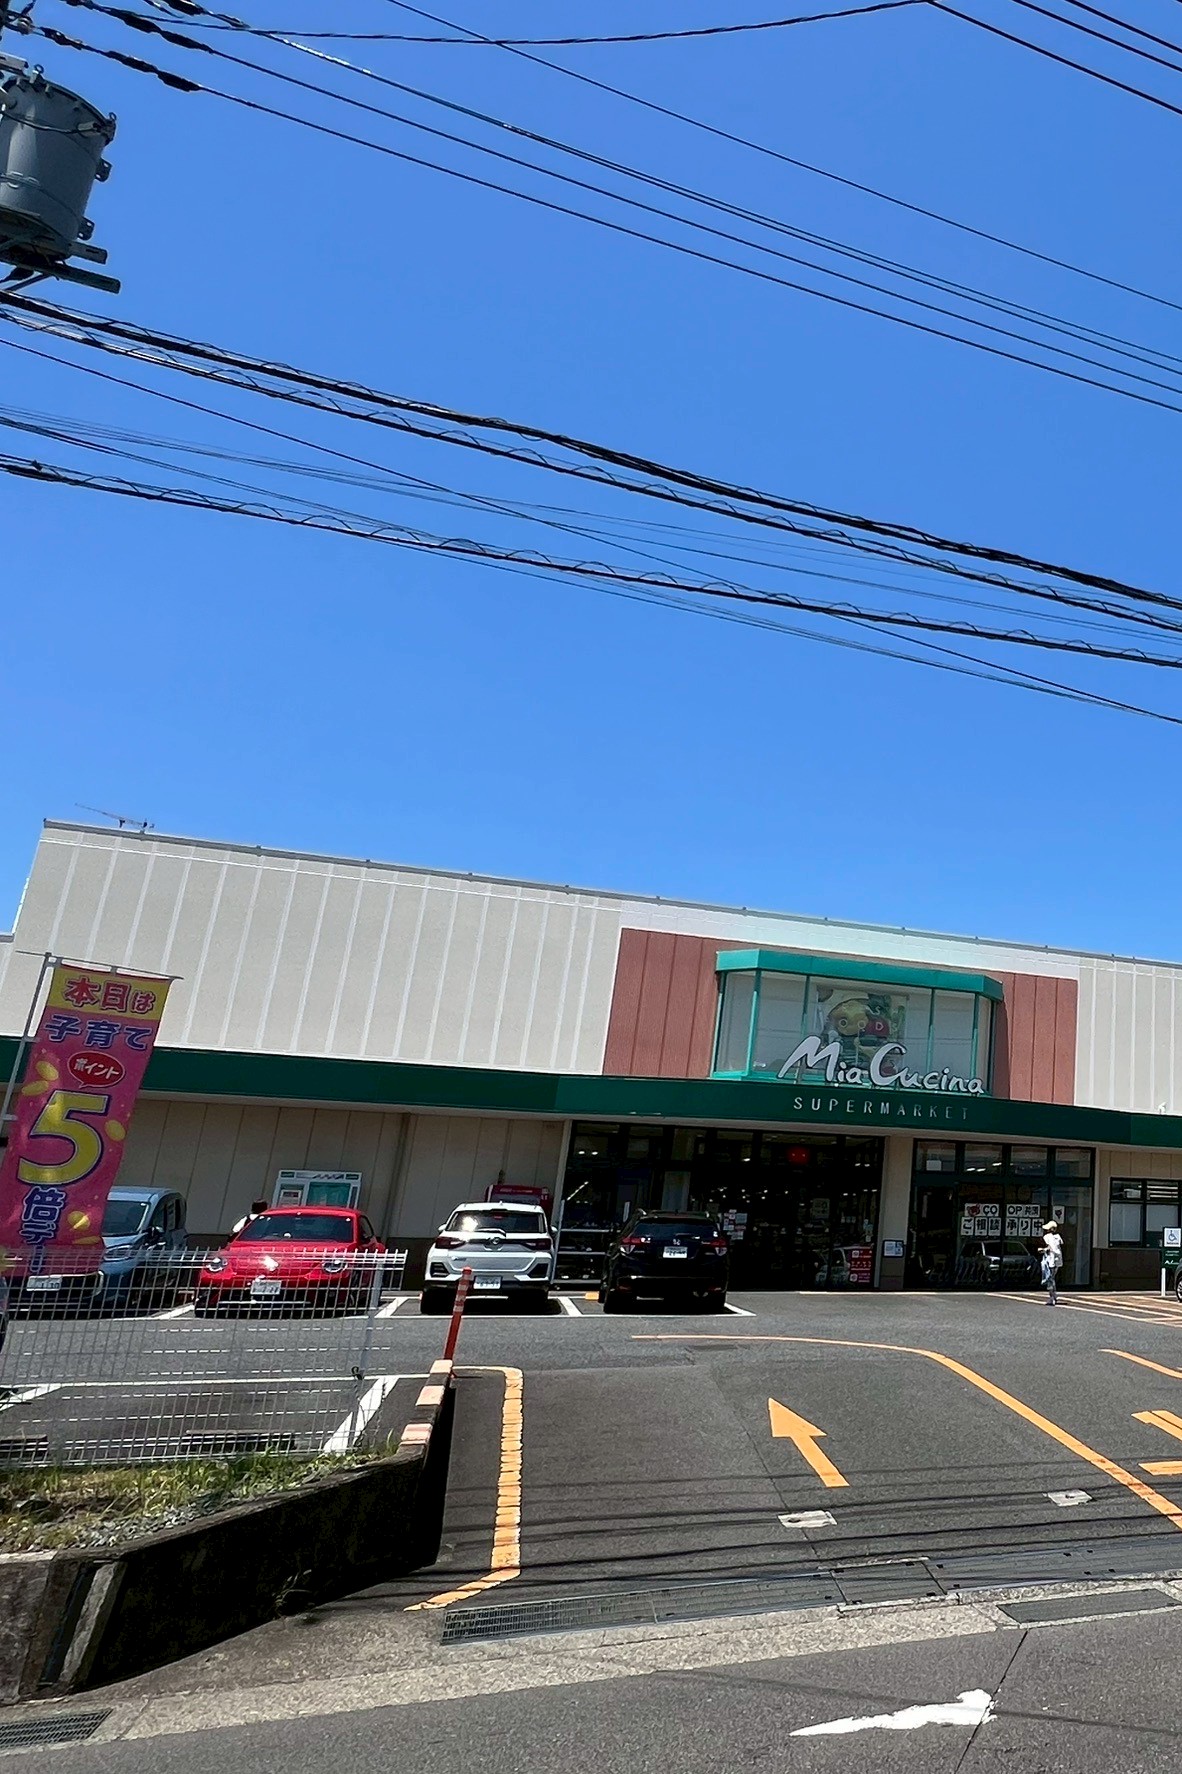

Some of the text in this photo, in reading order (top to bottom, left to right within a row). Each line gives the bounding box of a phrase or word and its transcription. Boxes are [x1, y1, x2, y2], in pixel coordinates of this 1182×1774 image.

[63, 976, 156, 1014] 本日は
[45, 1014, 152, 1050] 子育て
[74, 1058, 119, 1080] ポイント
[777, 1035, 985, 1094] Mia Cucina
[793, 1097, 969, 1120] SUPERMARKET
